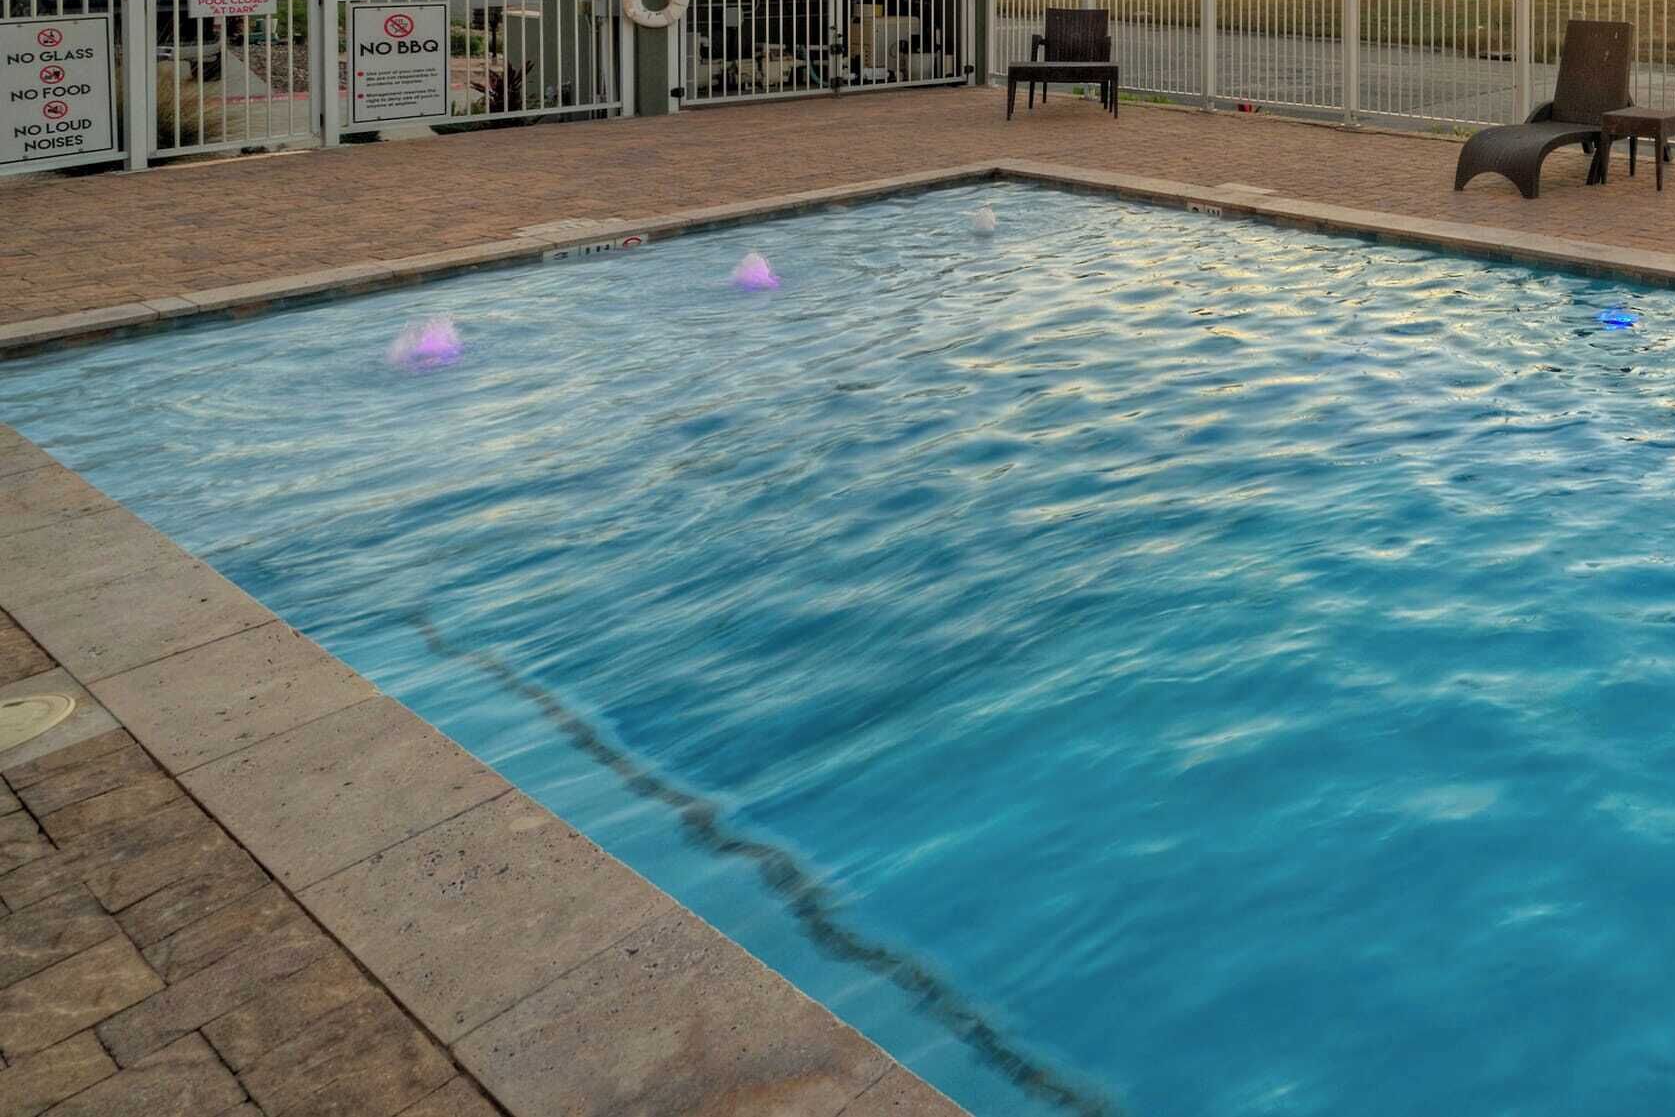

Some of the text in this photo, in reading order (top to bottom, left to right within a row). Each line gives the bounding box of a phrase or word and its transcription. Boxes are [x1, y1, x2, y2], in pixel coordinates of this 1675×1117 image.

[7, 48, 94, 65] NO GLASS
[360, 39, 439, 57] NO BBQ
[11, 84, 91, 102] NO FOOD
[14, 119, 92, 138] NO LOUD
[24, 134, 83, 152] NOISES
